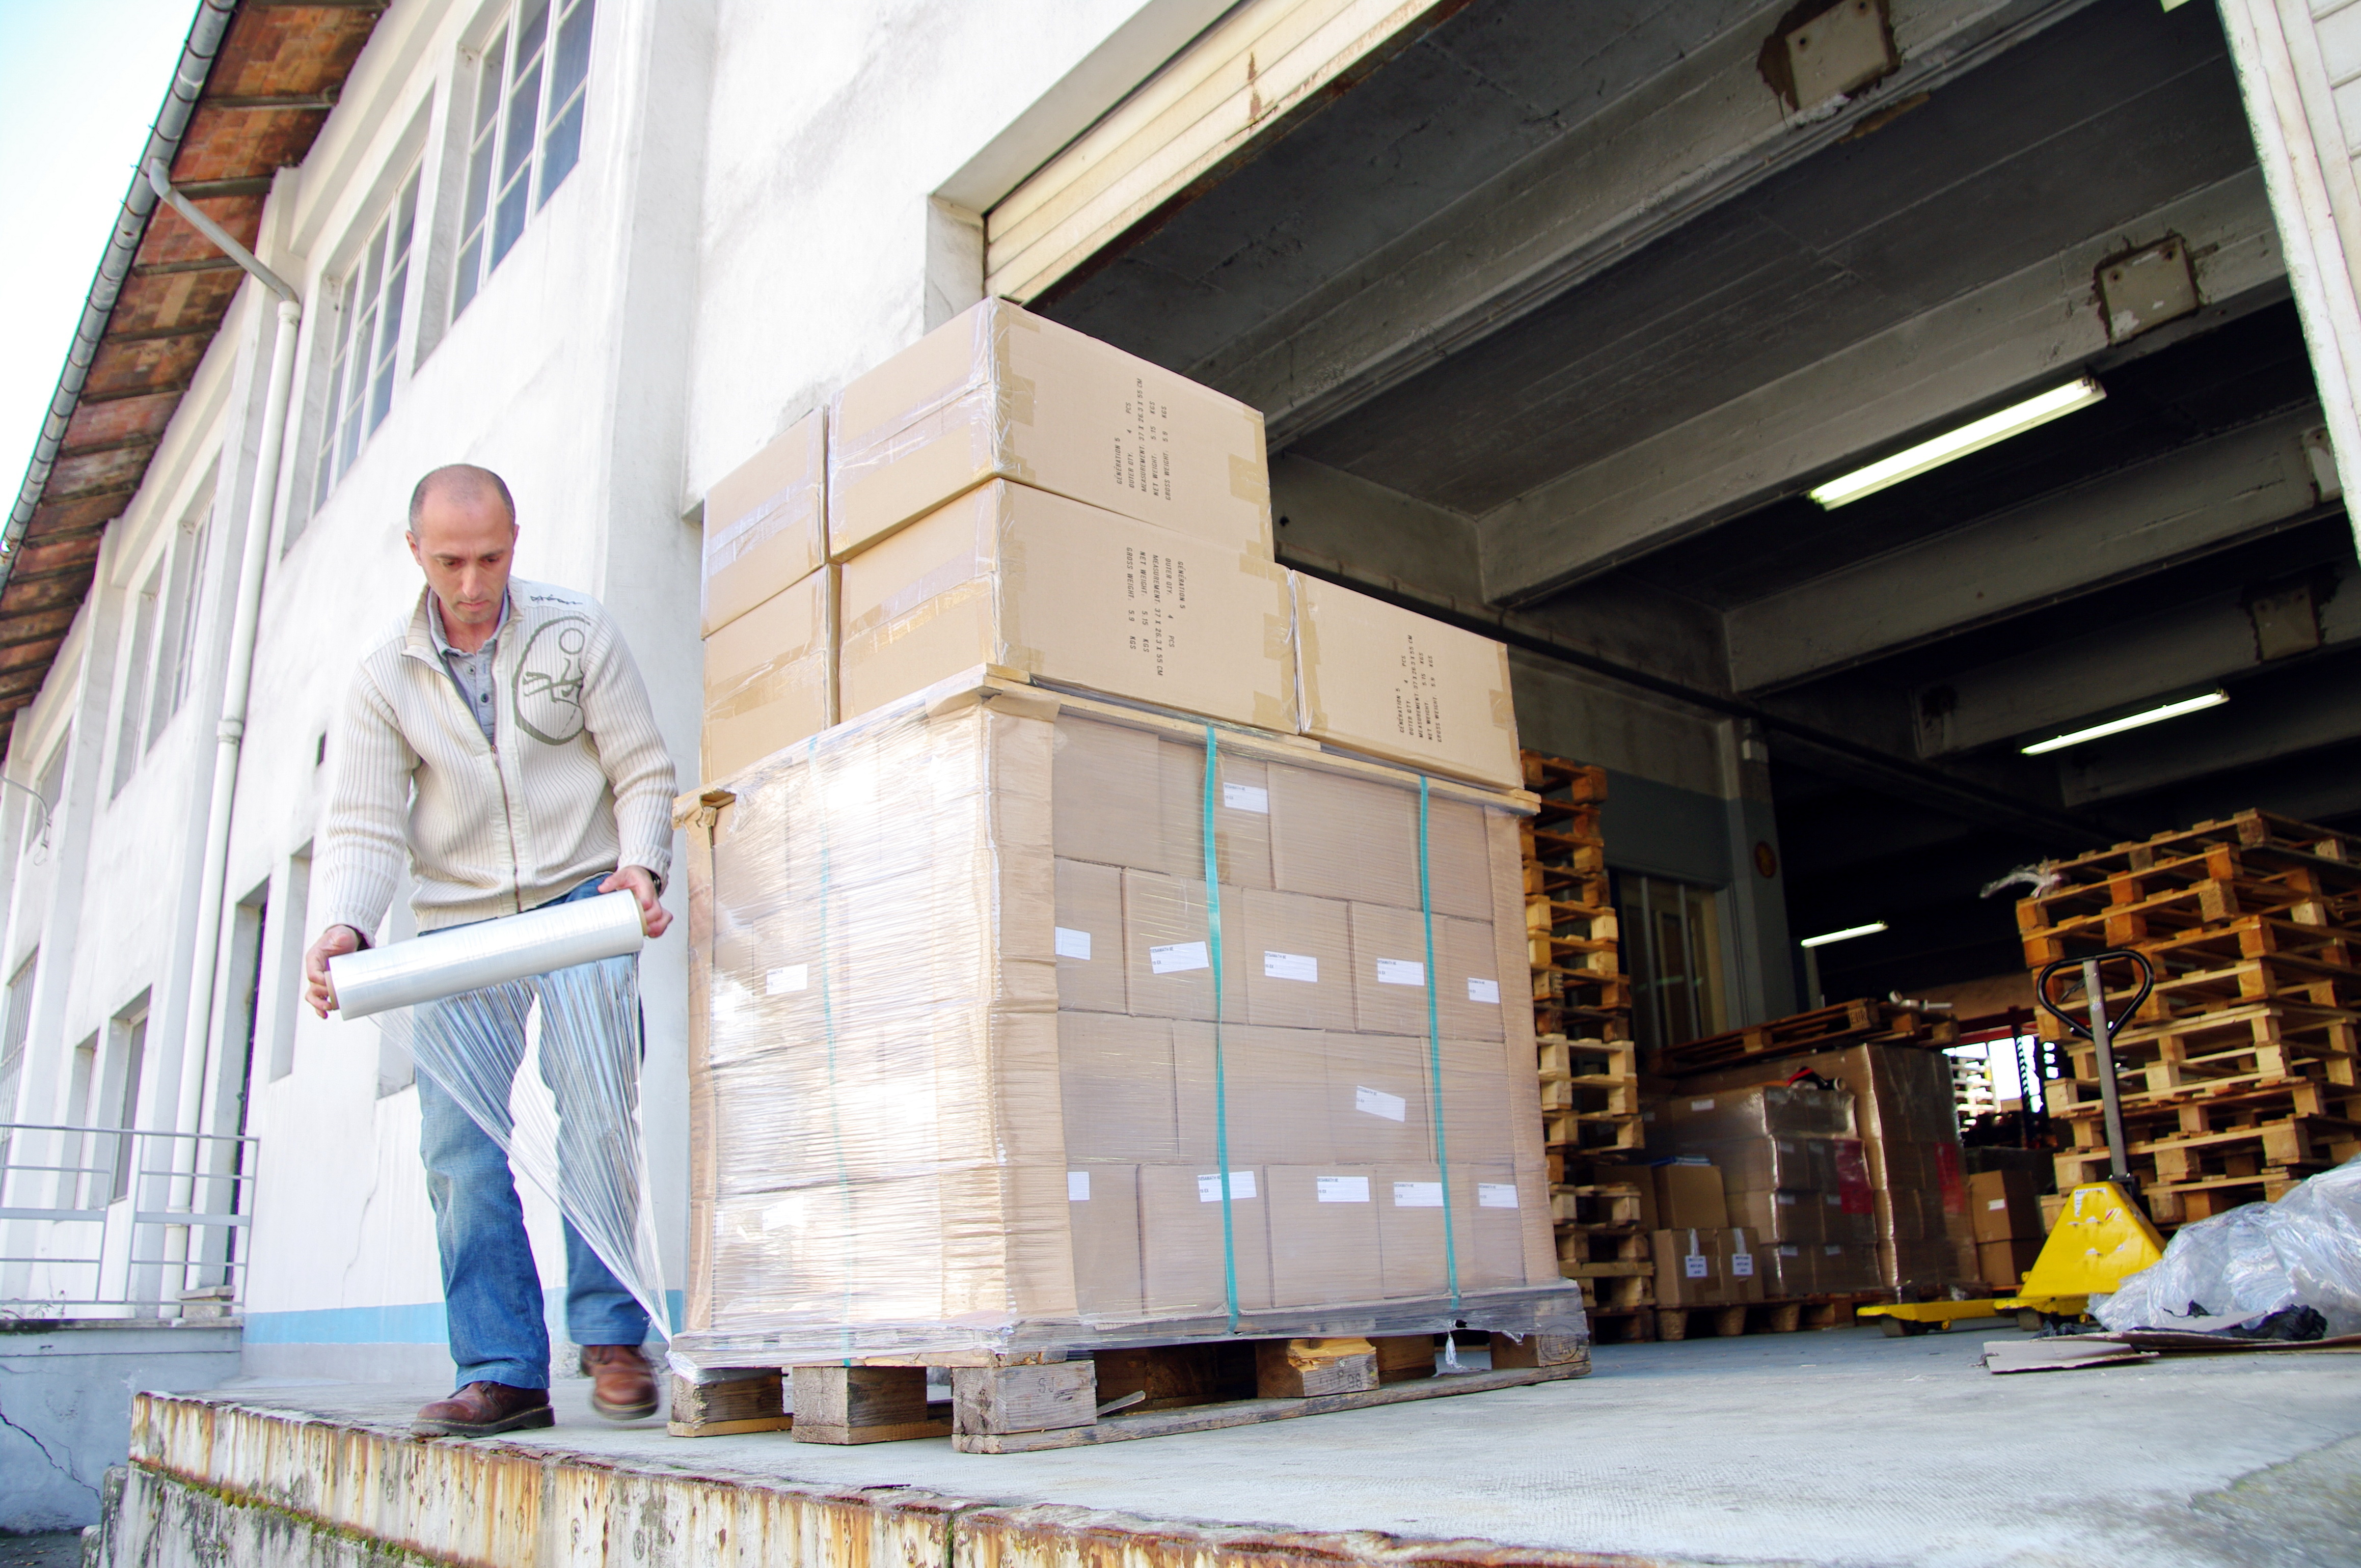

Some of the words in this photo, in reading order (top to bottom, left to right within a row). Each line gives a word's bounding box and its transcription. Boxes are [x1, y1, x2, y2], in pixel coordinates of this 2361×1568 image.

[1137, 378, 1143, 388] CM
[1137, 390, 1143, 398] 55
[1138, 432, 1145, 441] 37
[1114, 445, 1122, 484] GÉNÉRATION
[1178, 561, 1186, 601] GÉNÉRATION
[1154, 608, 1161, 617] 37
[1408, 635, 1413, 644] CM
[1156, 654, 1163, 663] 55
[1157, 666, 1163, 676] CM
[1396, 695, 1404, 733] GÉNÉRATION
[1851, 1010, 1867, 1024] EUR
